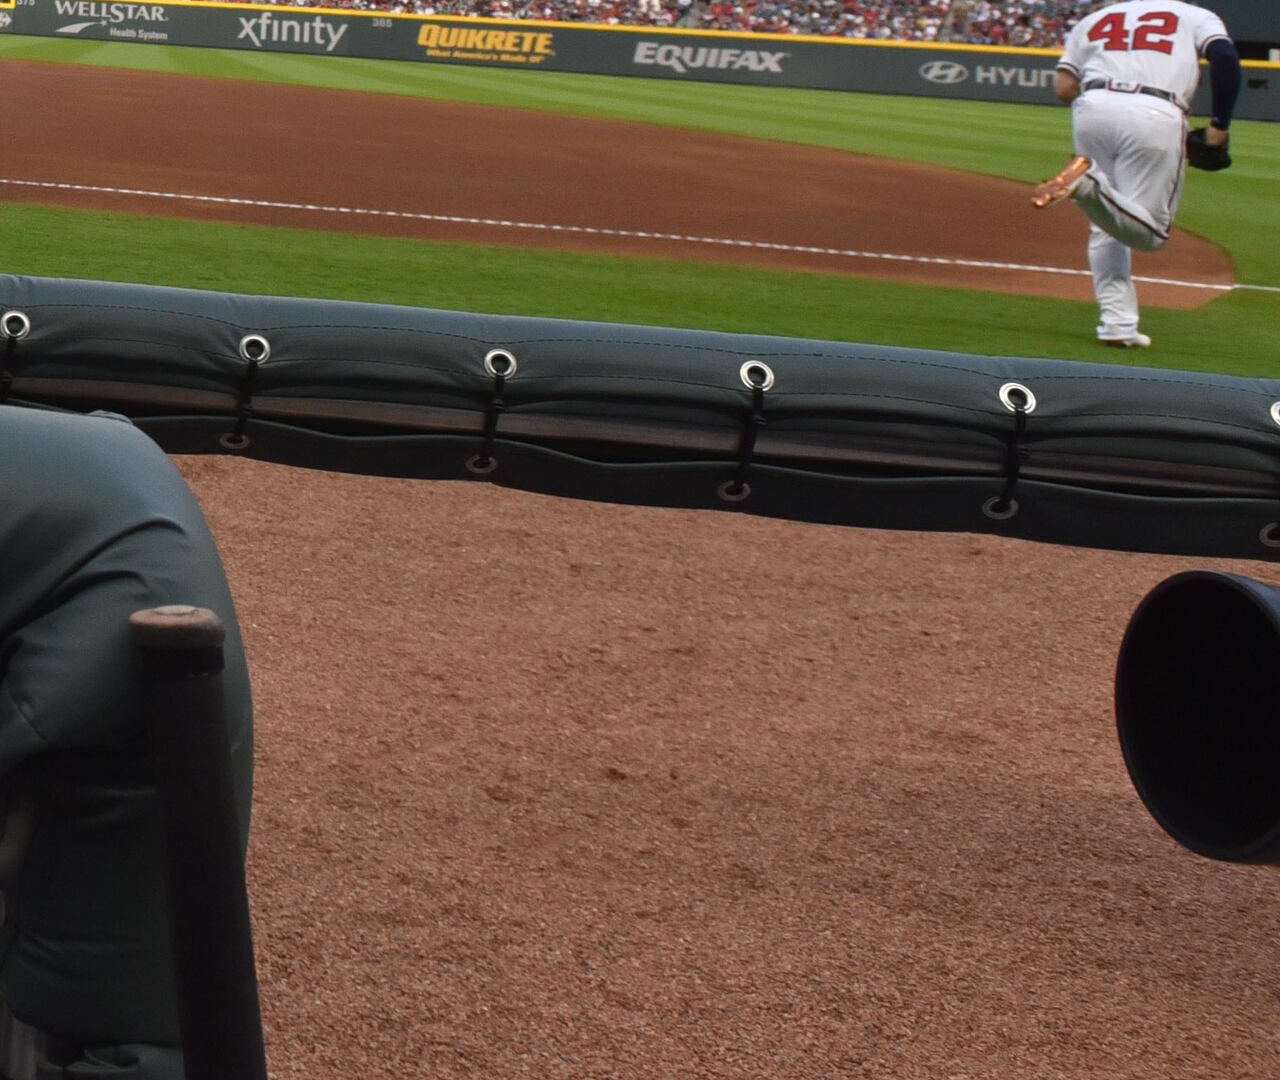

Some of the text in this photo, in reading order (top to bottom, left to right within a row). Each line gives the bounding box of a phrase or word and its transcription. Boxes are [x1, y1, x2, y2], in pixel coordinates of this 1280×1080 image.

[55, 0, 166, 23] WELLSTAR
[110, 27, 168, 40] Health System
[238, 12, 348, 52] xfinity
[417, 24, 554, 55] QUIKRETE
[1087, 11, 1180, 55] 42
[633, 41, 786, 72] EQUIFAX
